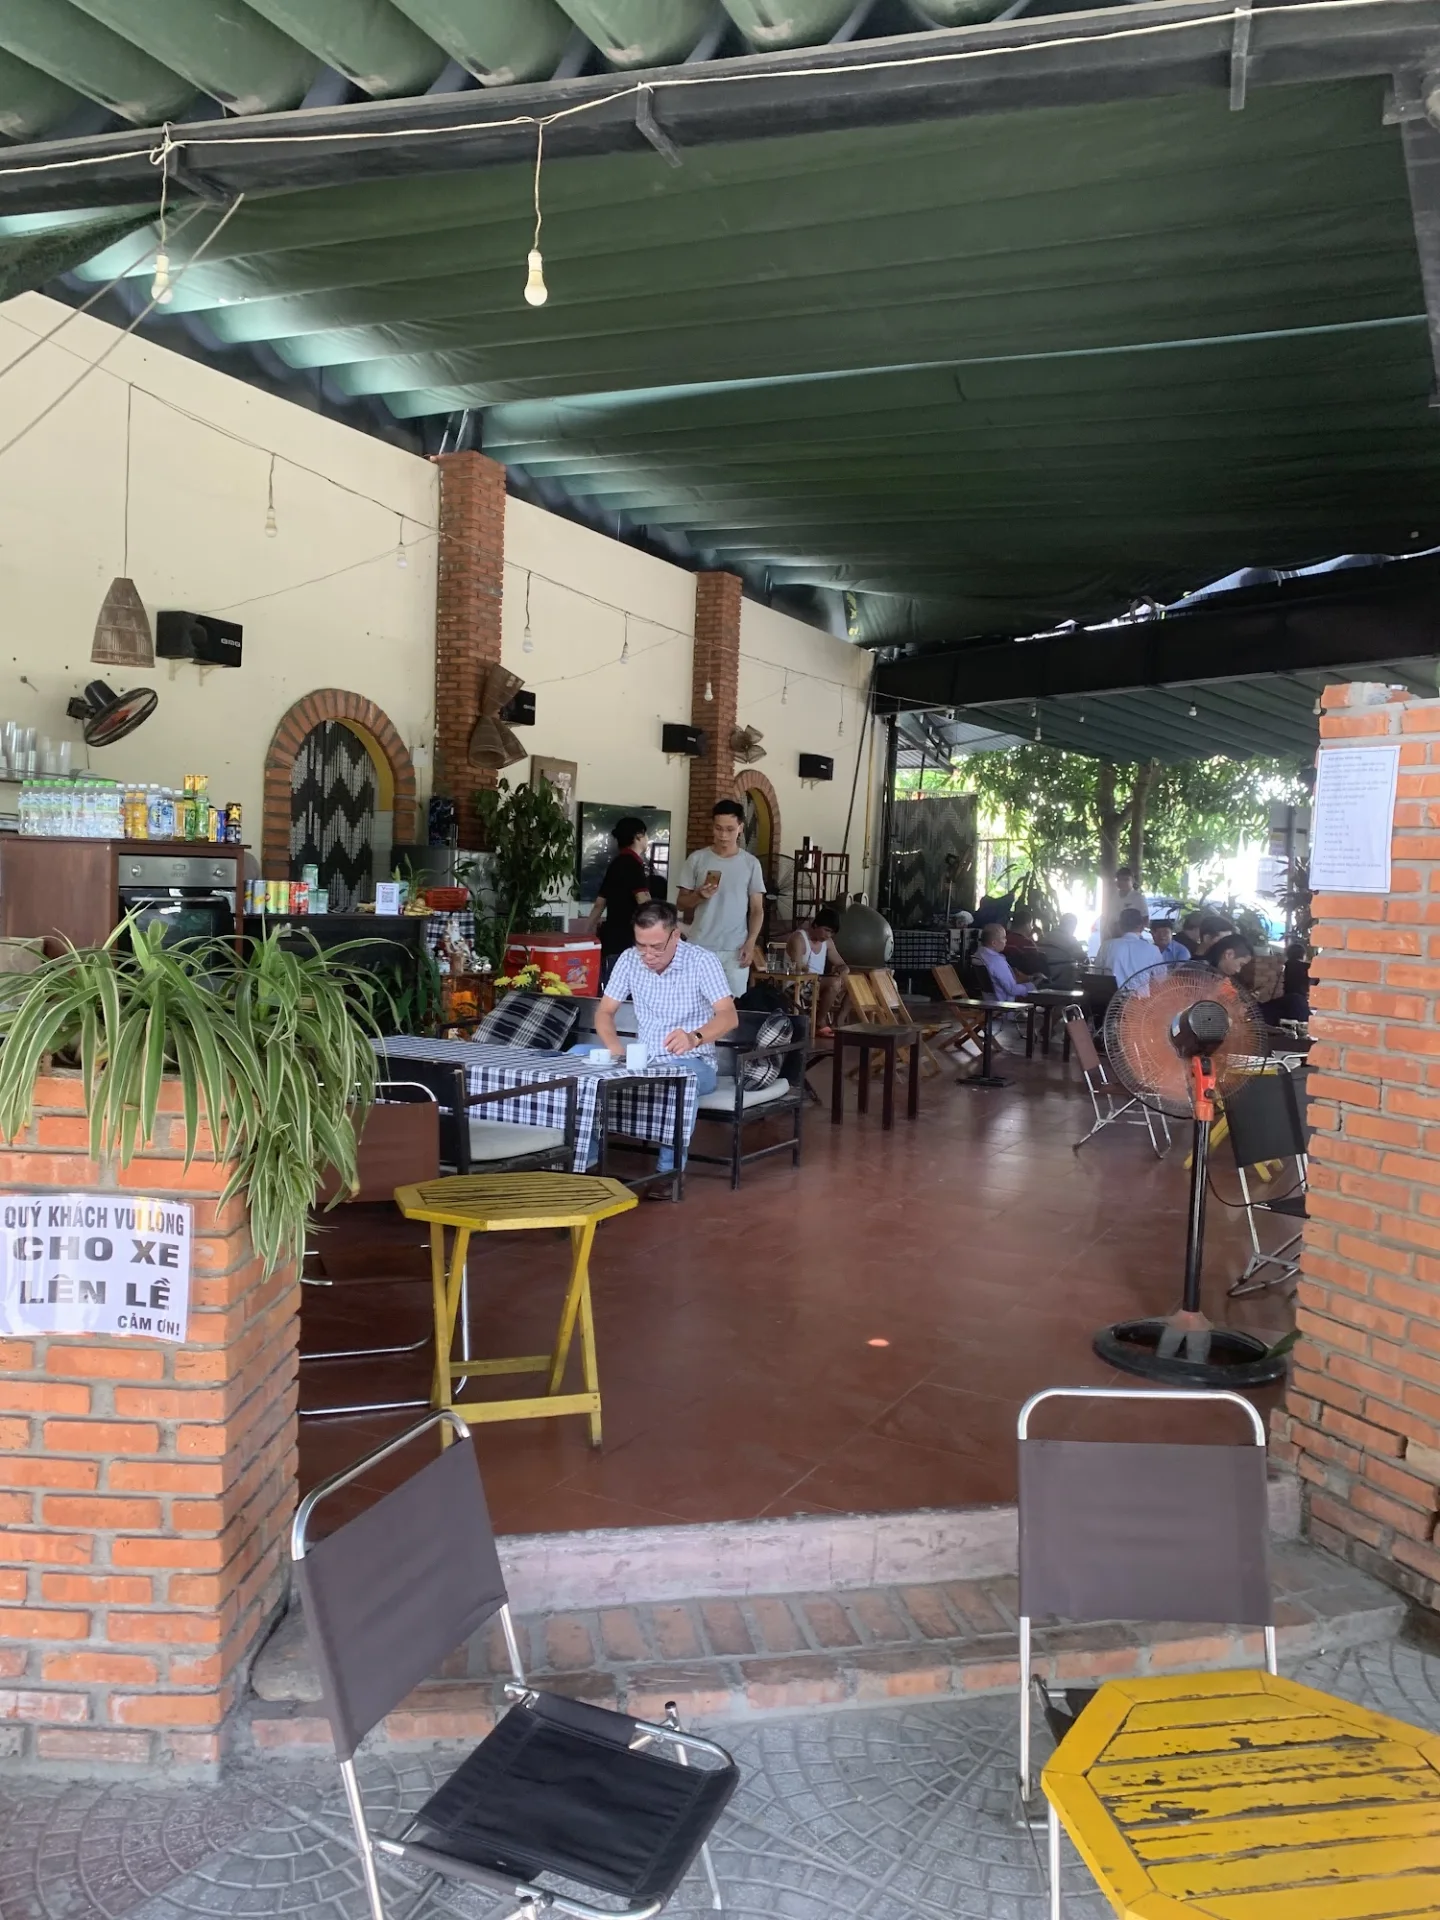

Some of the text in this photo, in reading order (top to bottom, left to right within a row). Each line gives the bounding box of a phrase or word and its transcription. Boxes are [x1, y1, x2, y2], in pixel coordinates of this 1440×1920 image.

[5, 1200, 184, 1236] QUÝ KHÁCH VUI LÒNG
[13, 1236, 179, 1268] CHO XE
[19, 1274, 171, 1310] LÊN LỀ
[117, 1312, 180, 1336] CẢM ƠN!
